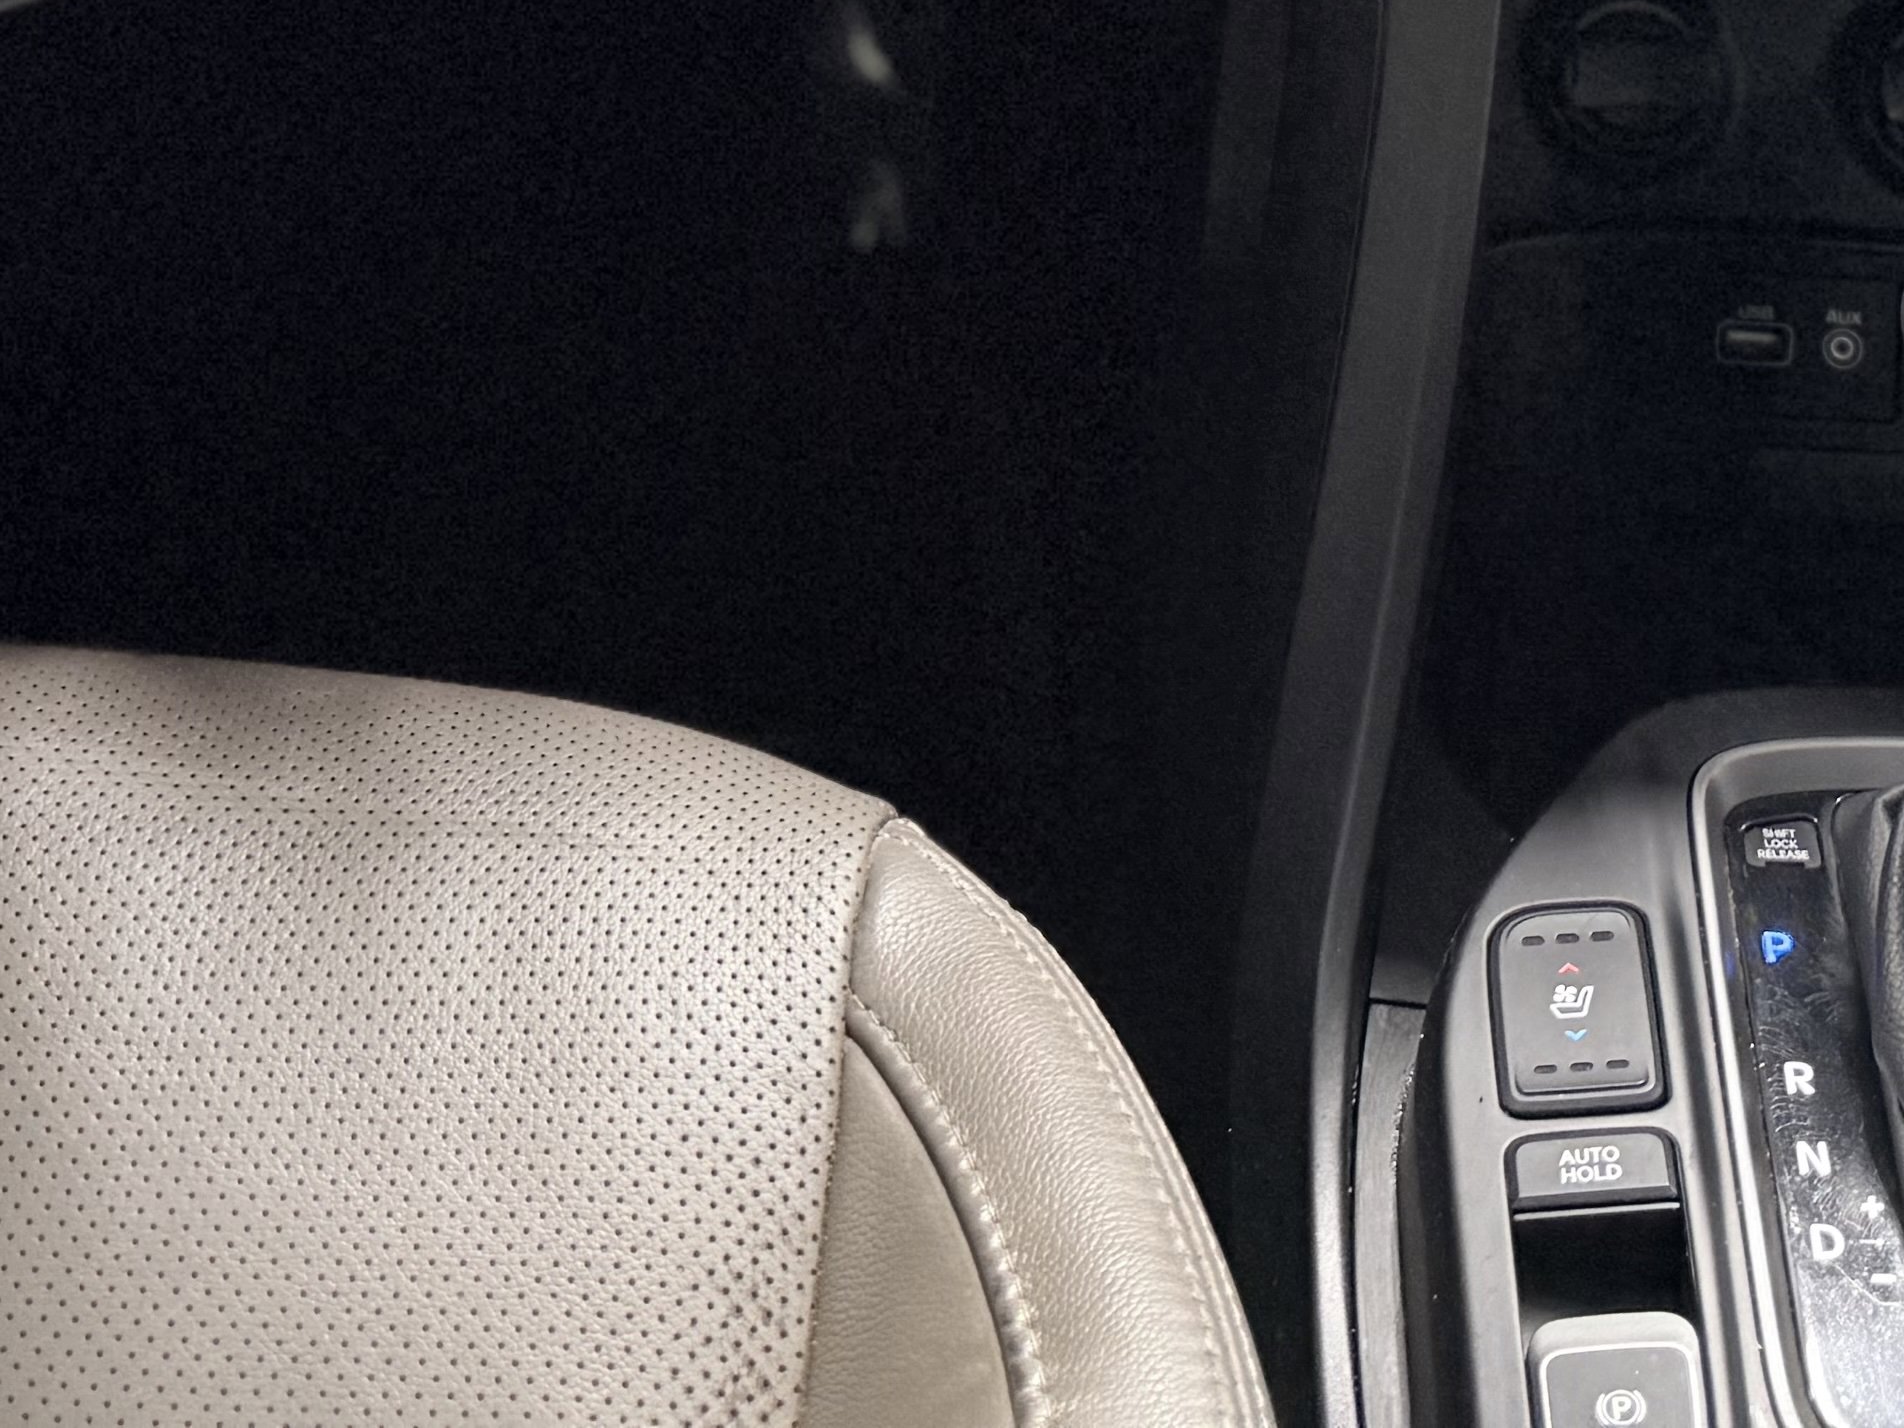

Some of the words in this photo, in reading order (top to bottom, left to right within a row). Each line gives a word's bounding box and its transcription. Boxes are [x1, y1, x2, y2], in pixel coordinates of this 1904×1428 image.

[1826, 308, 1862, 325] AUX
[1757, 848, 1810, 860] RELEASE
[1763, 838, 1799, 850] LOCK
[1761, 931, 1795, 964] P
[1784, 1061, 1815, 1095] R
[1559, 1146, 1620, 1167] AUTO
[1796, 1141, 1832, 1177] N
[1560, 1163, 1623, 1185] HOLD
[1810, 1224, 1845, 1260] D
